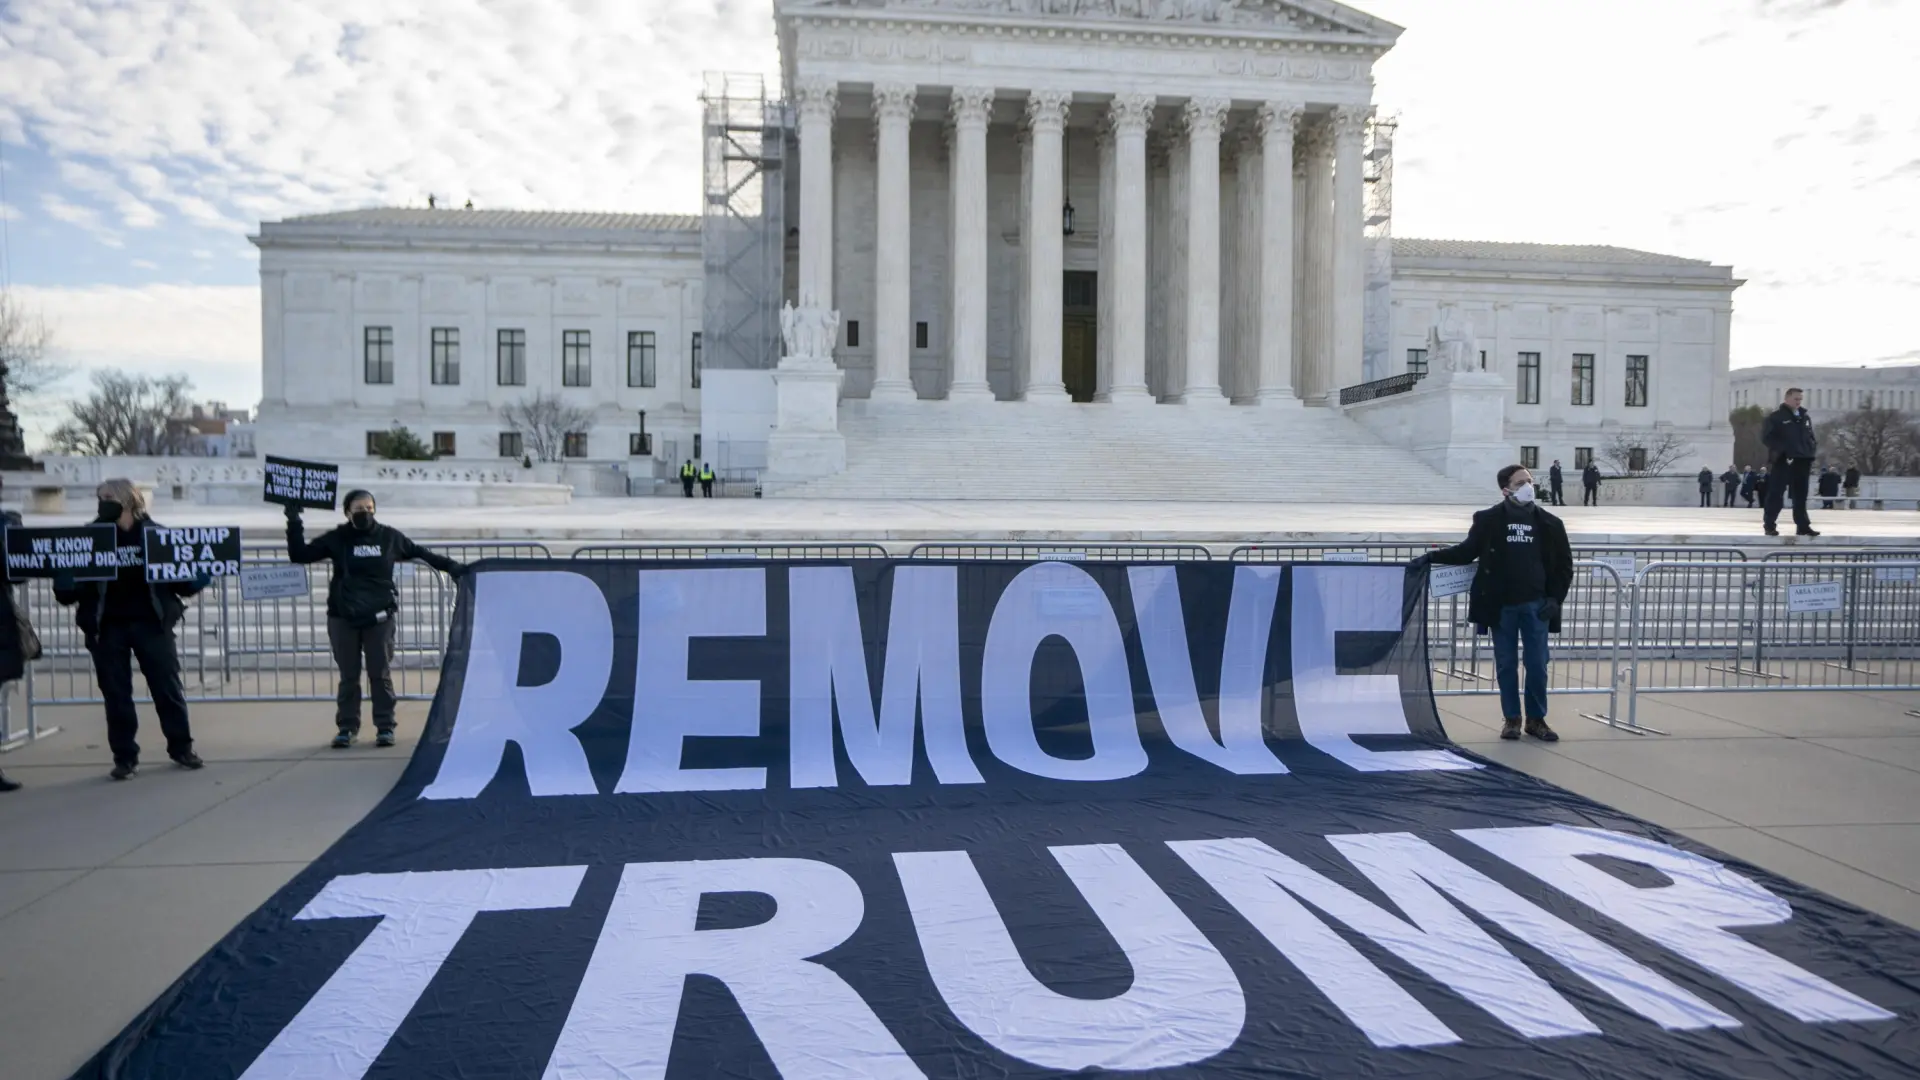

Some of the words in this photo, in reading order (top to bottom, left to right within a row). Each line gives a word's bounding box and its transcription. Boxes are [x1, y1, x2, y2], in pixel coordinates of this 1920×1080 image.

[265, 463, 302, 478] WITCHES
[305, 468, 338, 482] KNOW
[272, 474, 290, 487] THIS
[292, 478, 302, 488] IS
[304, 479, 327, 491] NOT
[266, 483, 273, 495] A
[273, 485, 300, 499] WITCH
[303, 489, 334, 502] HUNT
[1507, 523, 1532, 531] TRUMP
[32, 538, 53, 553] WE
[55, 536, 94, 553] KNOW
[156, 527, 230, 546] TRUMP
[1506, 535, 1534, 543] GUILTY
[8, 553, 46, 569] WHAT
[48, 552, 93, 568] TRUMP
[173, 545, 195, 562] IS
[200, 544, 216, 561] A
[148, 560, 240, 580] TRAITOR
[1436, 571, 1453, 579] AREA
[416, 561, 1487, 800] REMOVE
[237, 824, 1898, 1080] TRUMP
